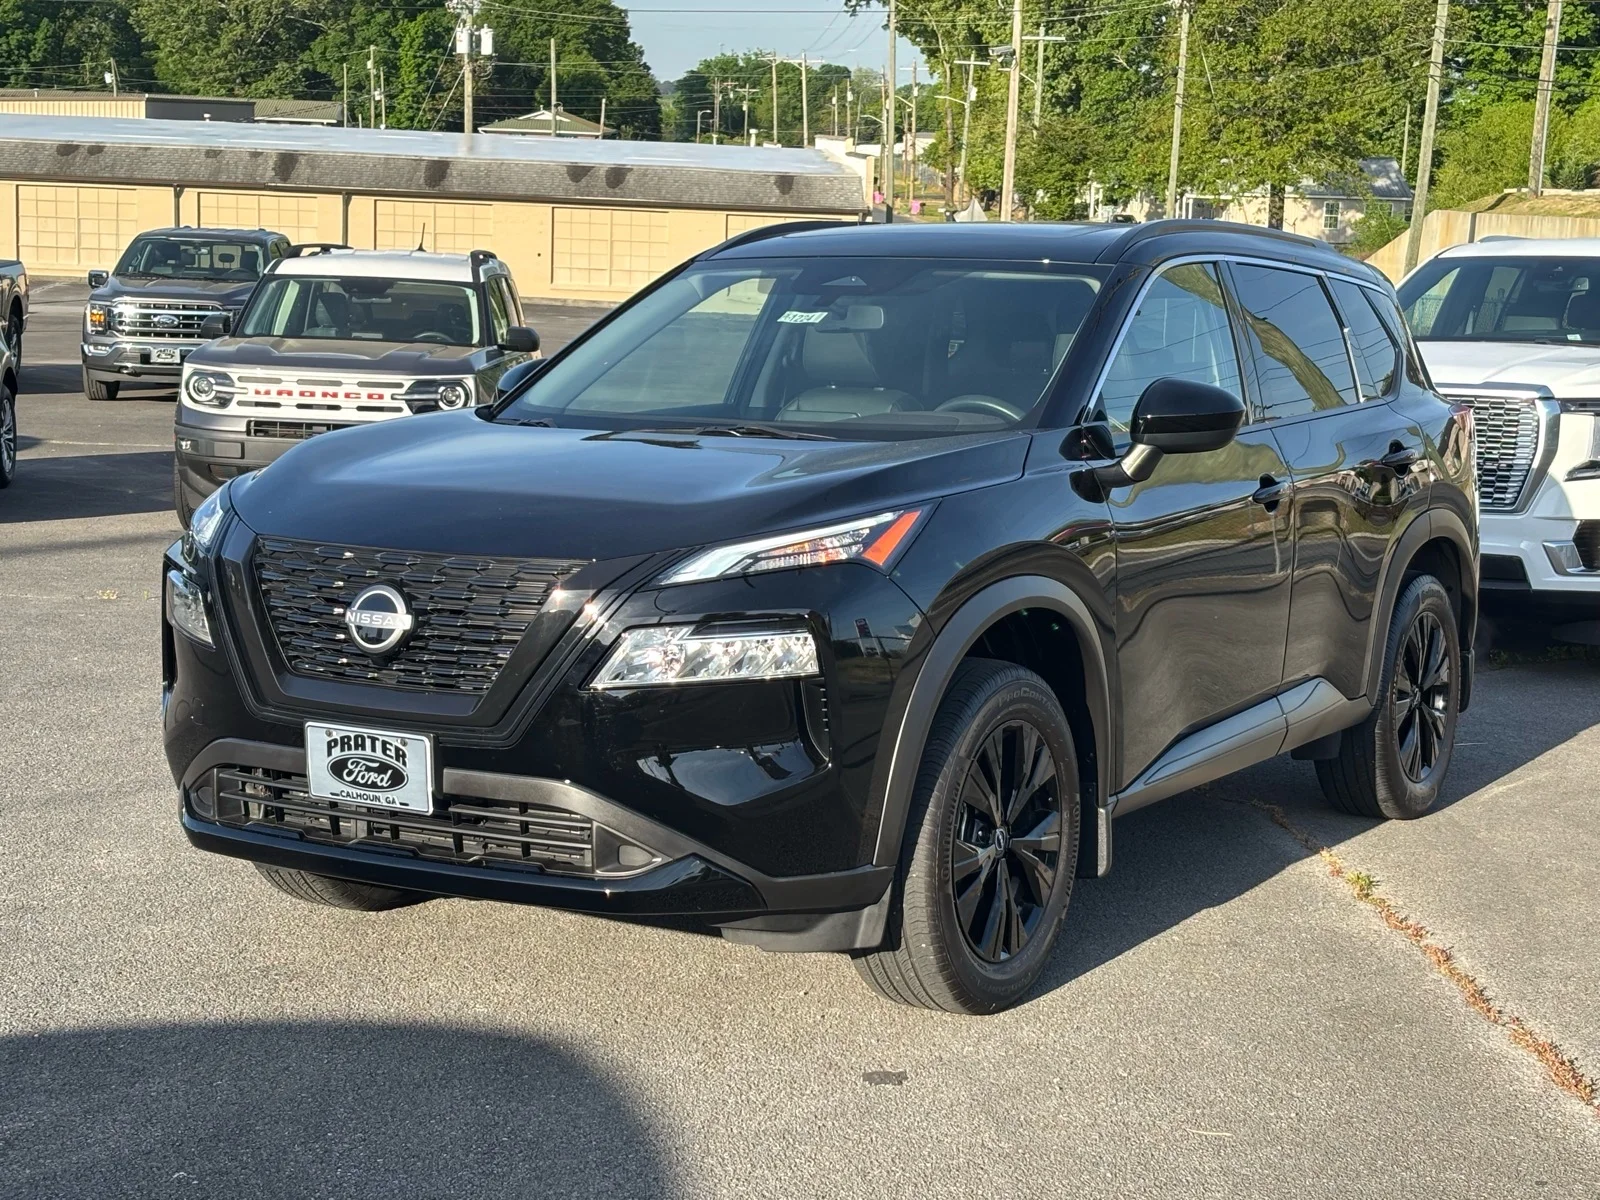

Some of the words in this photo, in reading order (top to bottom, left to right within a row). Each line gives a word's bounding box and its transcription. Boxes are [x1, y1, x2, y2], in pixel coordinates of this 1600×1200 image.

[327, 734, 408, 768] PRATER
[343, 758, 393, 787] Ford
[385, 796, 397, 805] GA
